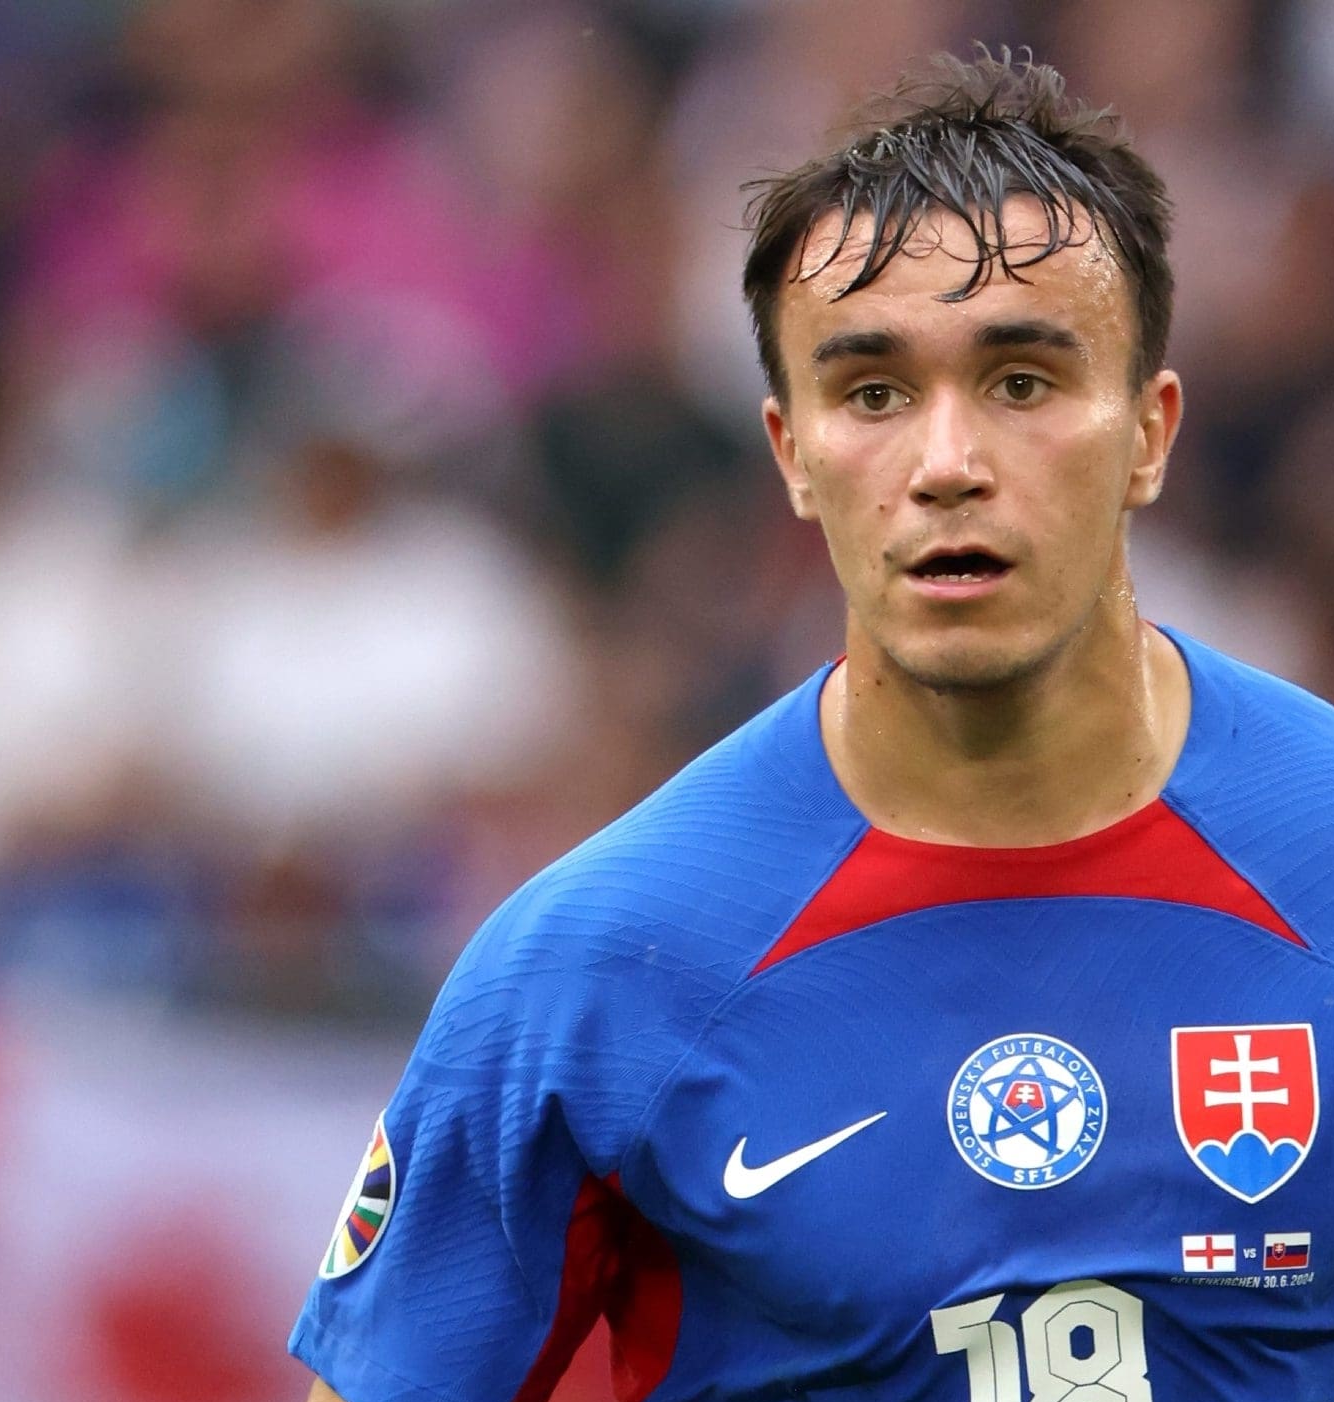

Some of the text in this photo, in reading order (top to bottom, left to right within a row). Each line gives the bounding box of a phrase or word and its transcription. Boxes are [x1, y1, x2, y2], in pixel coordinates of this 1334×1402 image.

[954, 1059, 992, 1168] SLOVENSKÝ
[992, 1040, 1099, 1094] FUTBALOVÝ
[1013, 1166, 1057, 1183] SFZ
